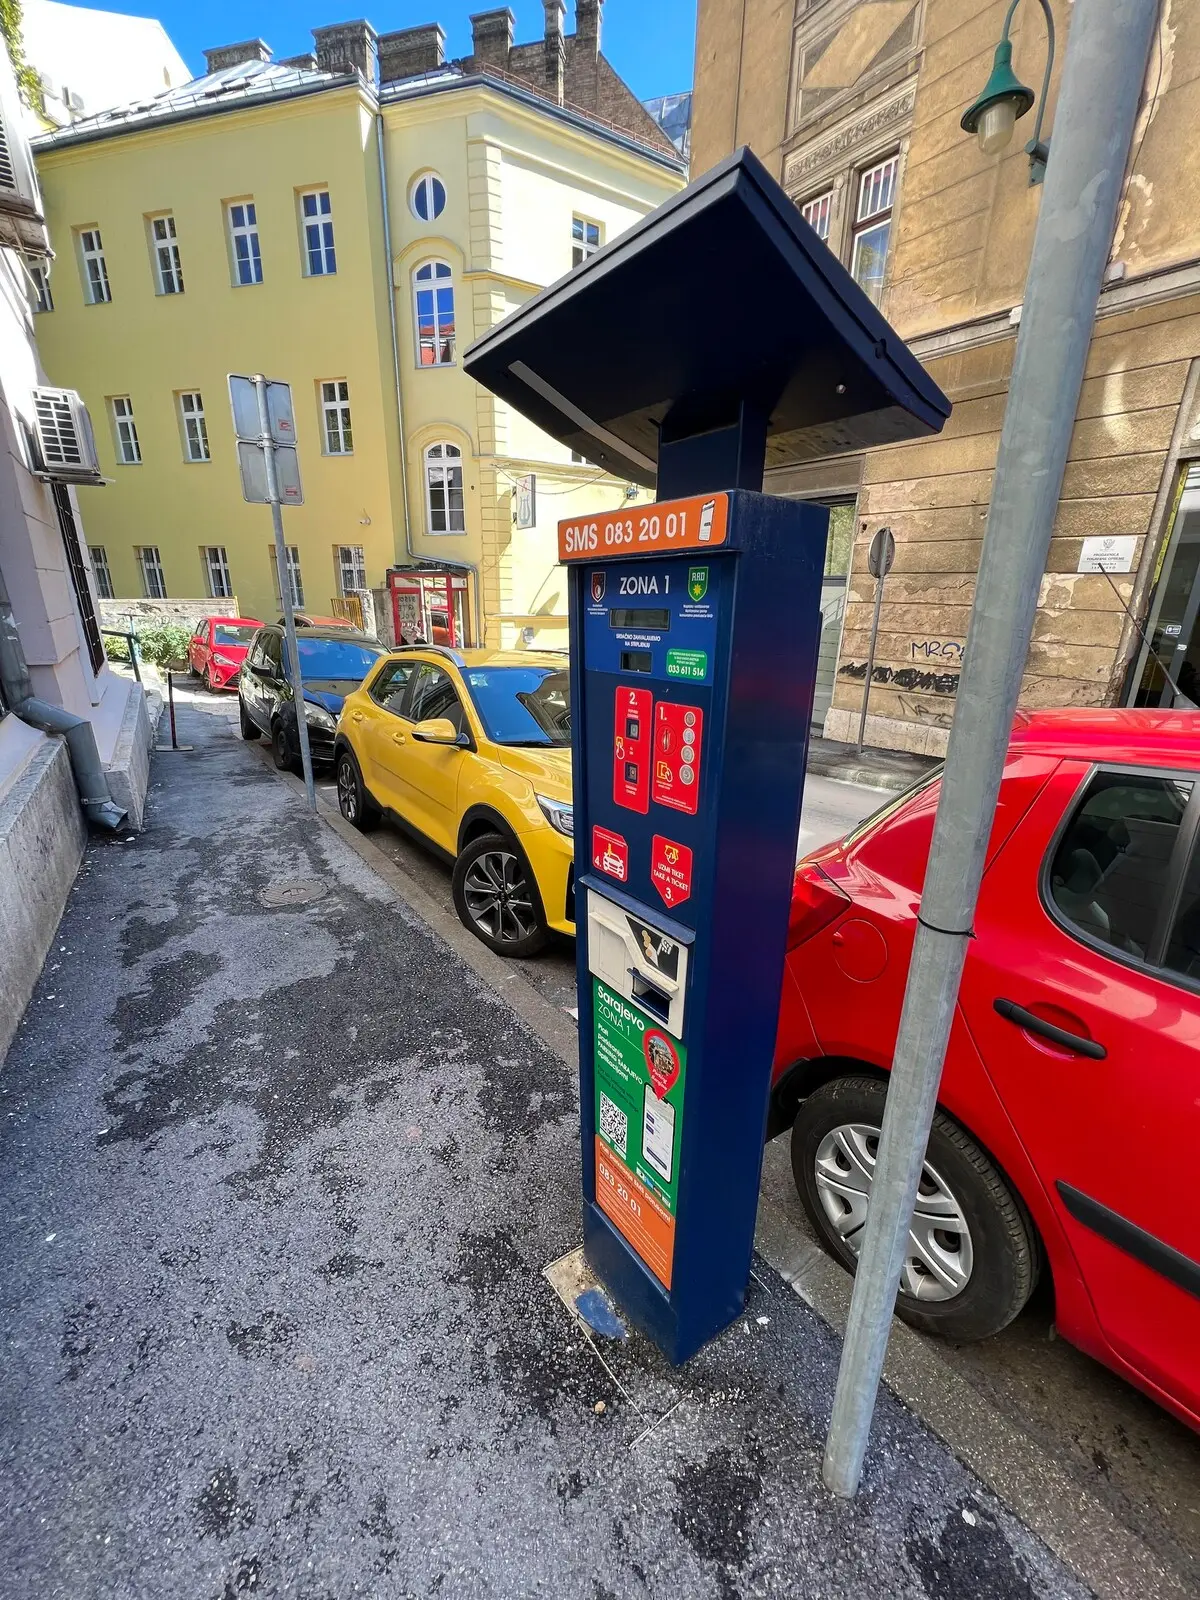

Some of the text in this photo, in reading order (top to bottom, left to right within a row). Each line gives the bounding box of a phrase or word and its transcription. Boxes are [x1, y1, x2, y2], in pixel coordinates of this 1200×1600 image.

[565, 512, 686, 552] SMS 083 20 01
[620, 575, 670, 595] ZONA 1
[668, 664, 704, 677] 033 611 514
[629, 691, 638, 705] 2.
[660, 707, 667, 720] 1.
[594, 855, 602, 867] 4.
[657, 862, 684, 879] UZMI TIKET
[653, 869, 665, 881] TAKE
[671, 877, 688, 891] TICKET
[665, 887, 674, 901] 3.
[597, 985, 645, 1031] Sarajevo
[598, 1001, 630, 1036] ZONA 1
[599, 1163, 615, 1186] 083
[617, 1183, 628, 1201] 20
[630, 1199, 641, 1217] 01
